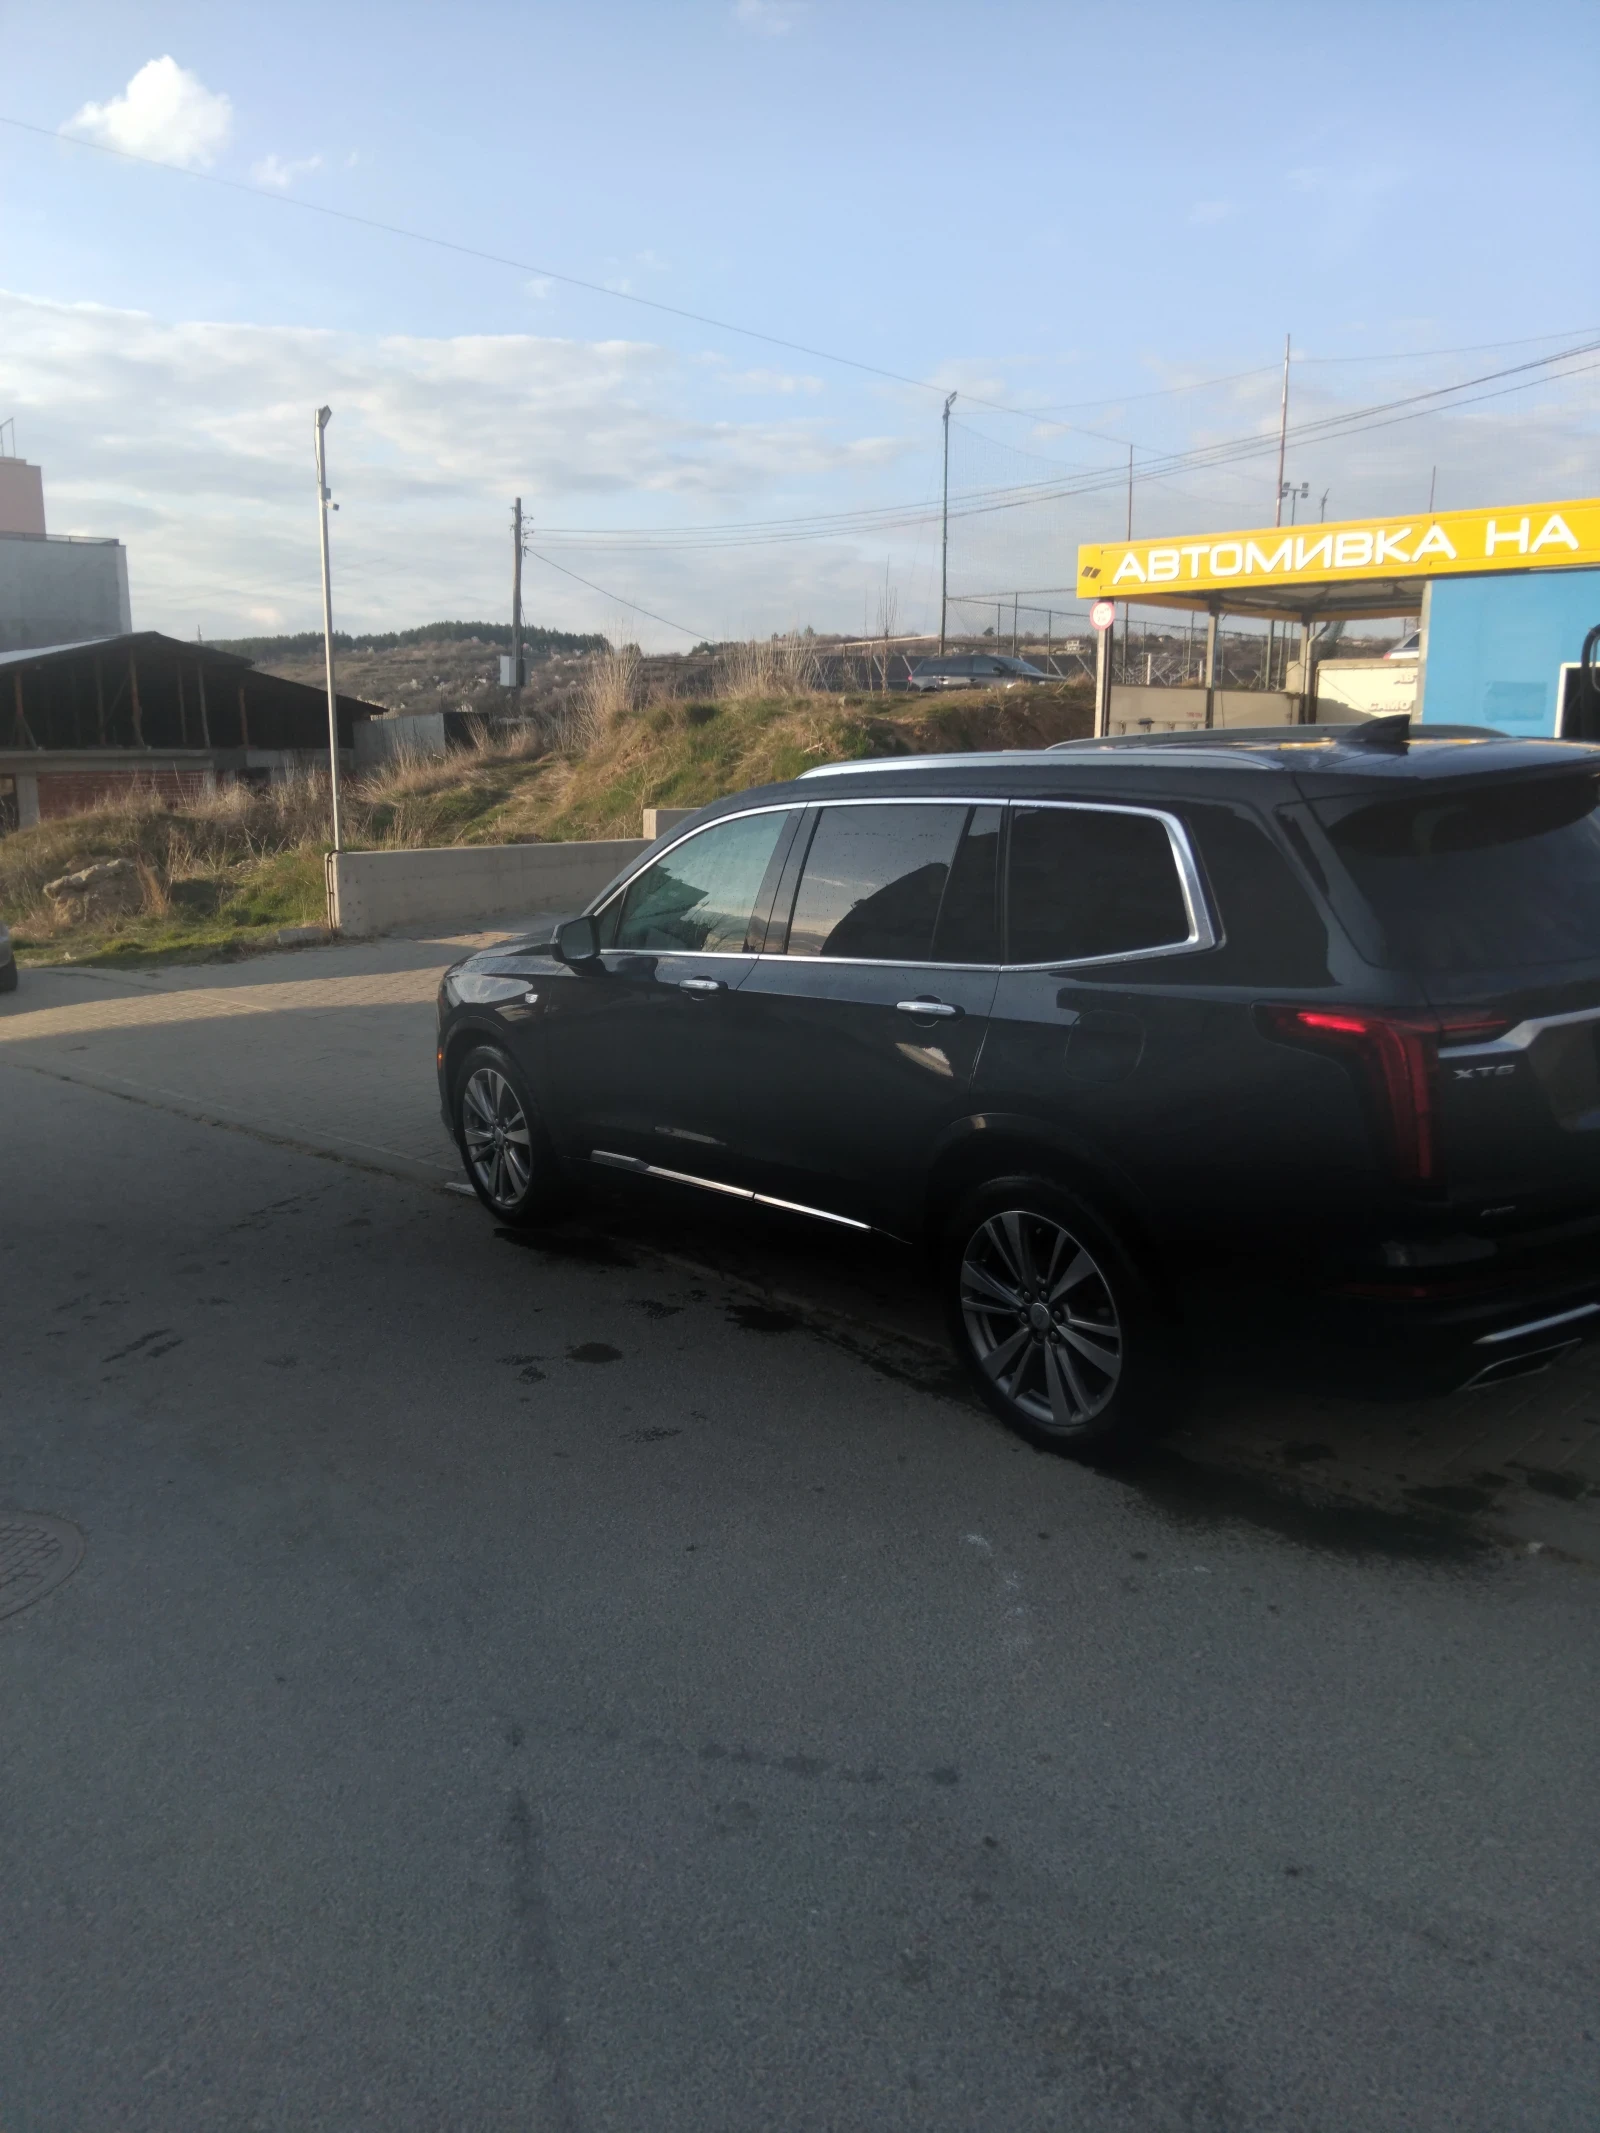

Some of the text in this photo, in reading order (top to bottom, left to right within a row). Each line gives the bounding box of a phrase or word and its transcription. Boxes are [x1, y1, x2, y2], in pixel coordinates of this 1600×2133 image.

[1112, 514, 1579, 586] АВТОМИВКА НА
[1452, 1063, 1516, 1080] XT6
